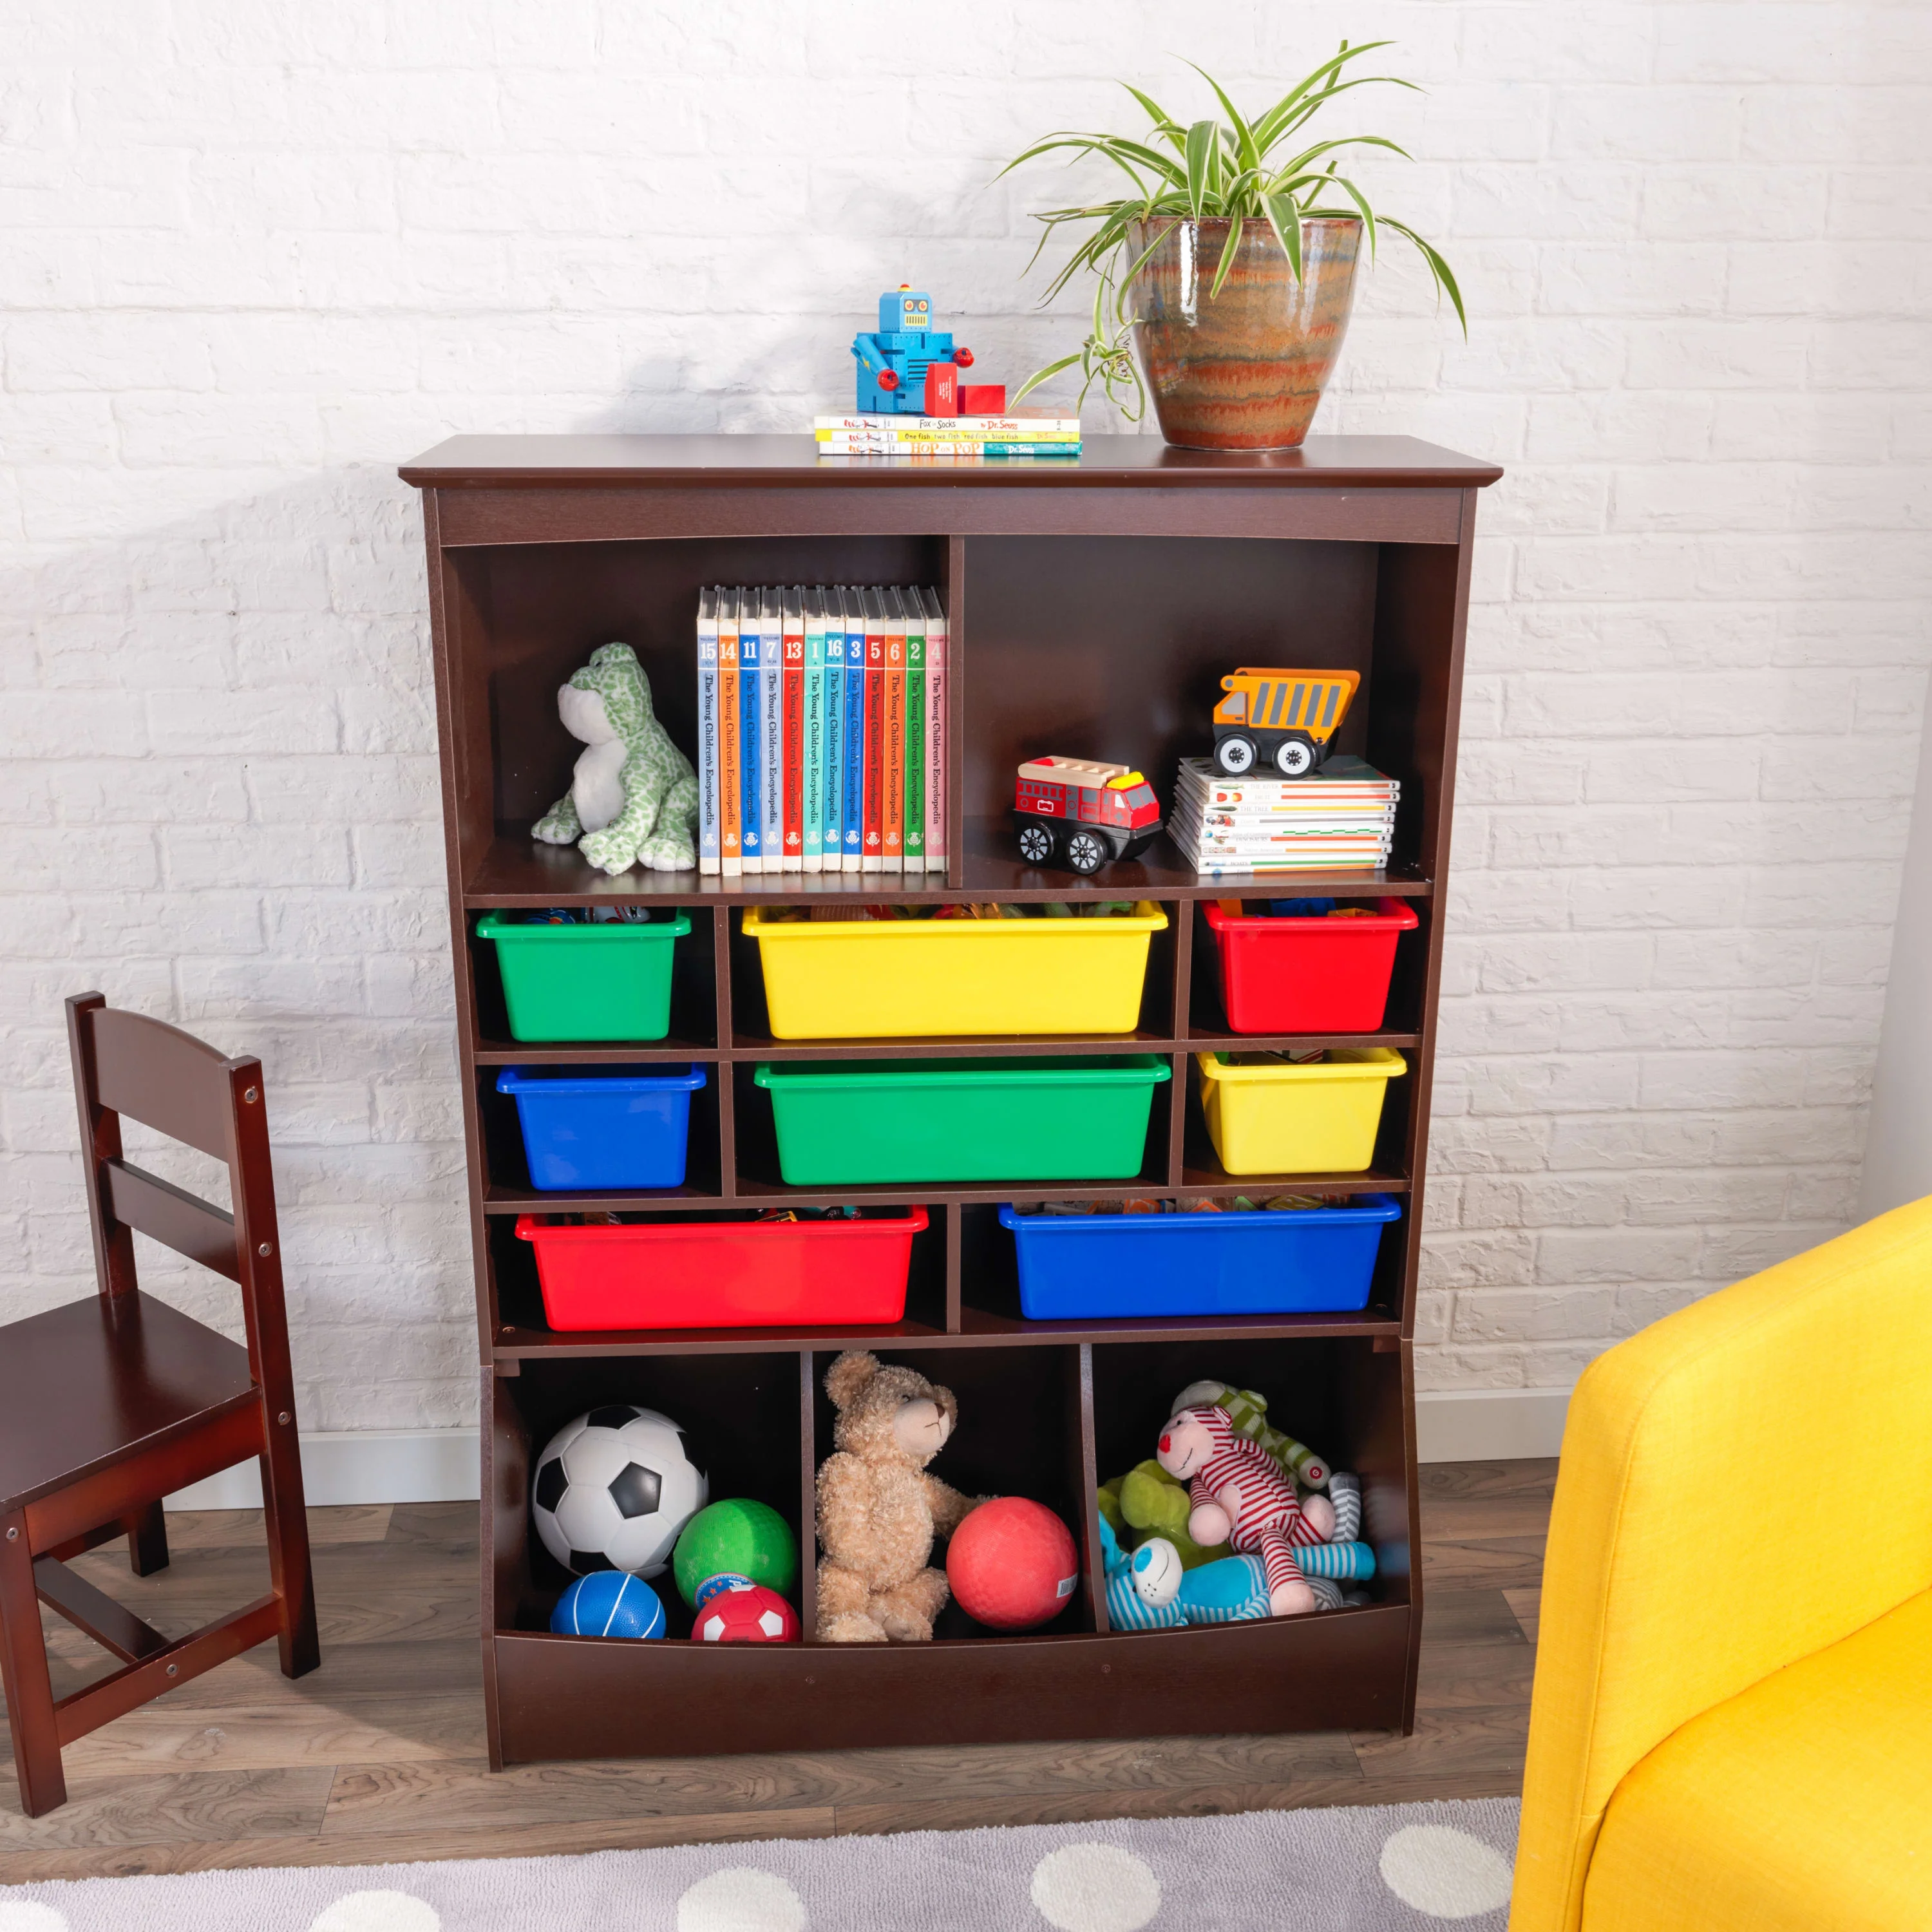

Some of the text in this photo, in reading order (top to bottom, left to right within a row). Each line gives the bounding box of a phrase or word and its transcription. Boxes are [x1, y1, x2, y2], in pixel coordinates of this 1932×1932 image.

[920, 419, 931, 428] Fox
[937, 419, 956, 429] Socks
[987, 421, 998, 430] Dr.
[999, 420, 1018, 430] Seuss
[1008, 444, 1034, 453] Dr. Seuss
[700, 642, 716, 659] 15
[720, 643, 736, 659] 14
[743, 641, 757, 658] 11
[766, 642, 776, 659] 7
[786, 642, 802, 659] 13
[812, 642, 819, 659] 1
[827, 639, 842, 656] 16
[850, 641, 861, 658] 3
[871, 642, 880, 659] 5
[890, 643, 900, 660] 6
[910, 643, 920, 659] 2
[931, 643, 942, 659] 4
[746, 693, 755, 720] Young
[890, 694, 900, 721] Young
[932, 694, 941, 721] Young
[704, 675, 714, 826] The Young Children's Encyclopedia
[724, 675, 735, 826] The Young Children's Encyclopedia
[746, 722, 755, 765] Children's
[767, 674, 777, 824] The Young Children's Encyclopedia
[788, 674, 799, 824] The Young Children's Encyclopedia
[810, 674, 820, 824] The Young Children's Encyclopedia
[828, 672, 839, 822] The Young Children's Encyclopedia
[849, 672, 860, 822] The Young Children's Encyclopedia
[869, 674, 880, 824] The Young Children's Encyclopedia
[891, 723, 899, 766] Children's
[910, 675, 920, 824] The Young Children's Encyclopedia
[933, 723, 941, 766] Children's
[746, 768, 755, 824] Encyclopedia
[889, 768, 898, 824] Encyclopedia
[931, 768, 941, 825] Encyclopedia
